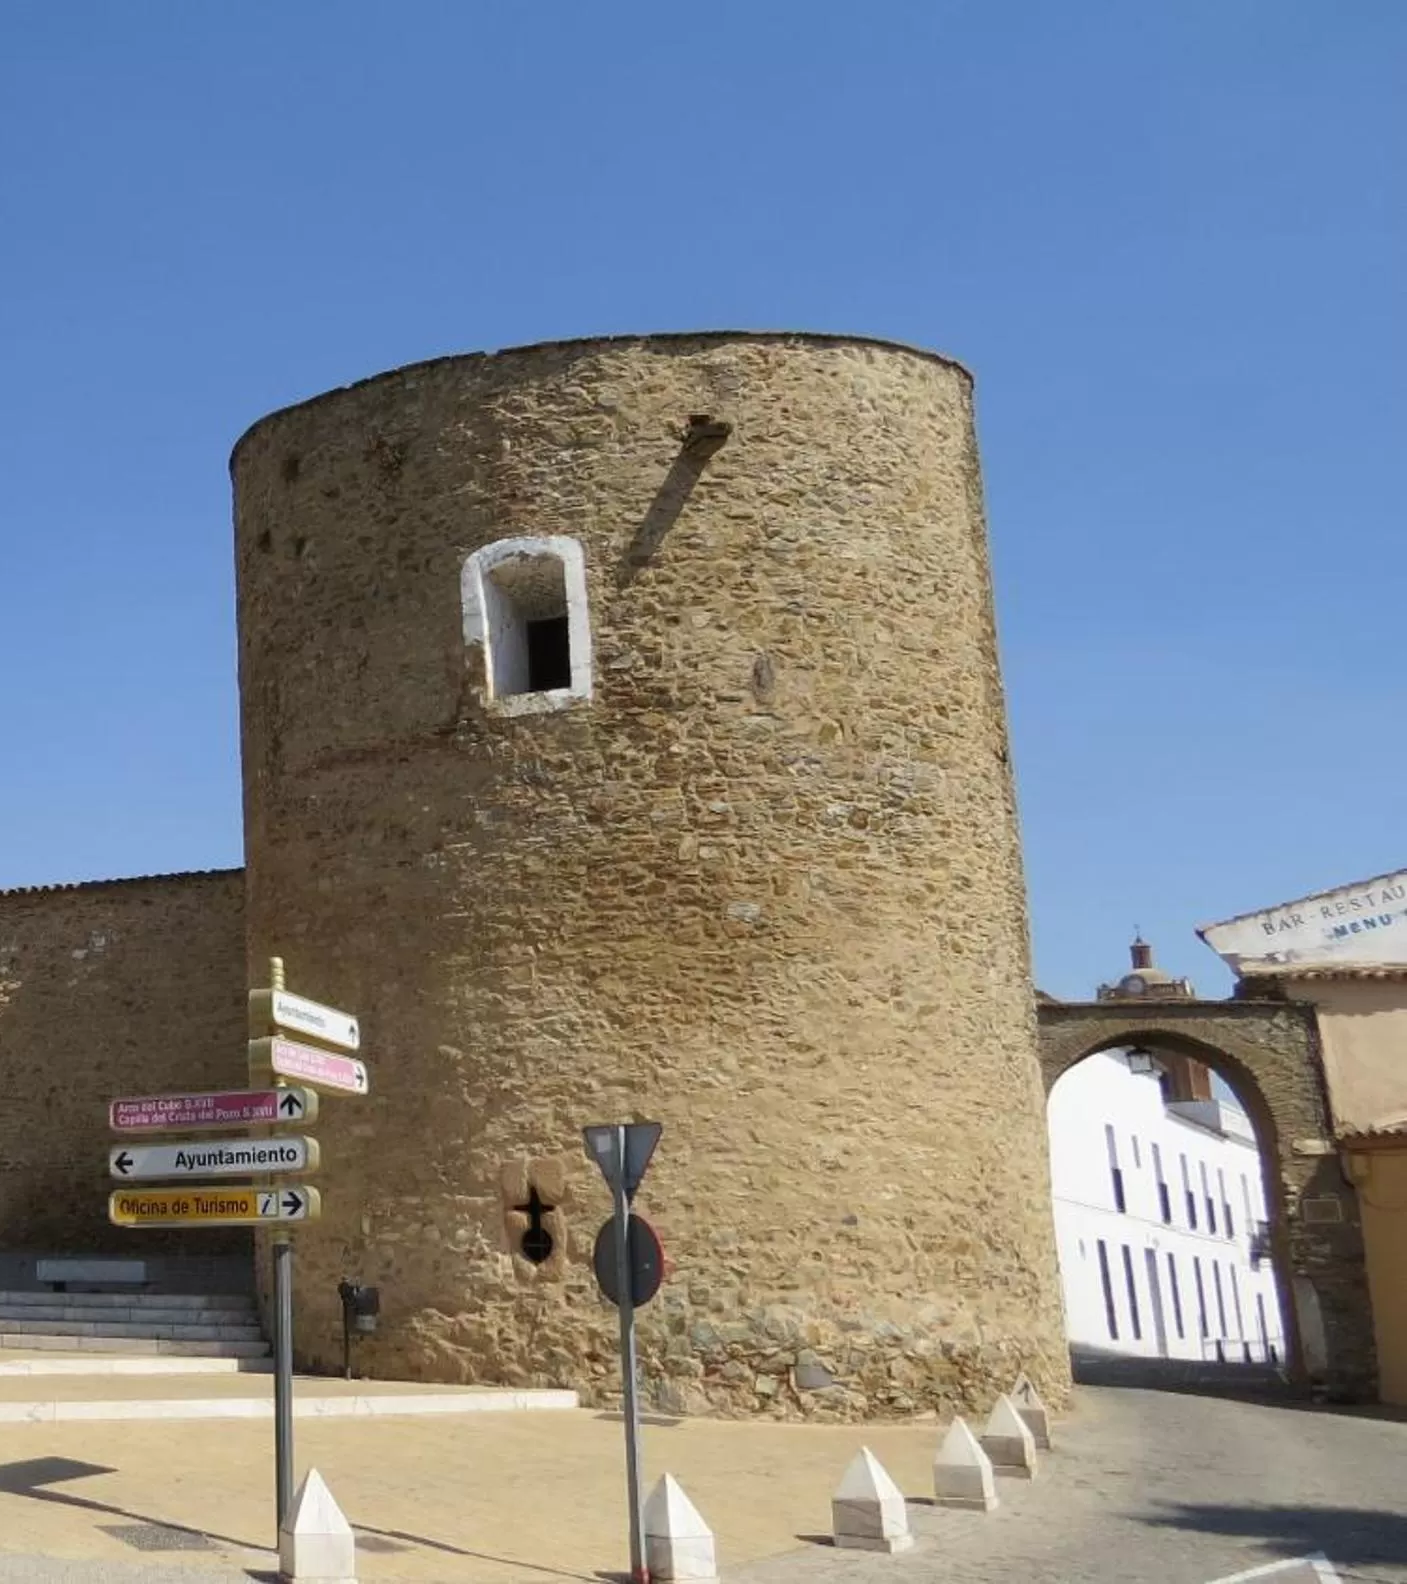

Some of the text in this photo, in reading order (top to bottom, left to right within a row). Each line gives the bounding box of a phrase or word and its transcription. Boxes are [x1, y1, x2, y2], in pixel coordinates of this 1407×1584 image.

[175, 1146, 297, 1170] Ayuntamiento
[120, 1196, 248, 1216] Oficina de Turismo
